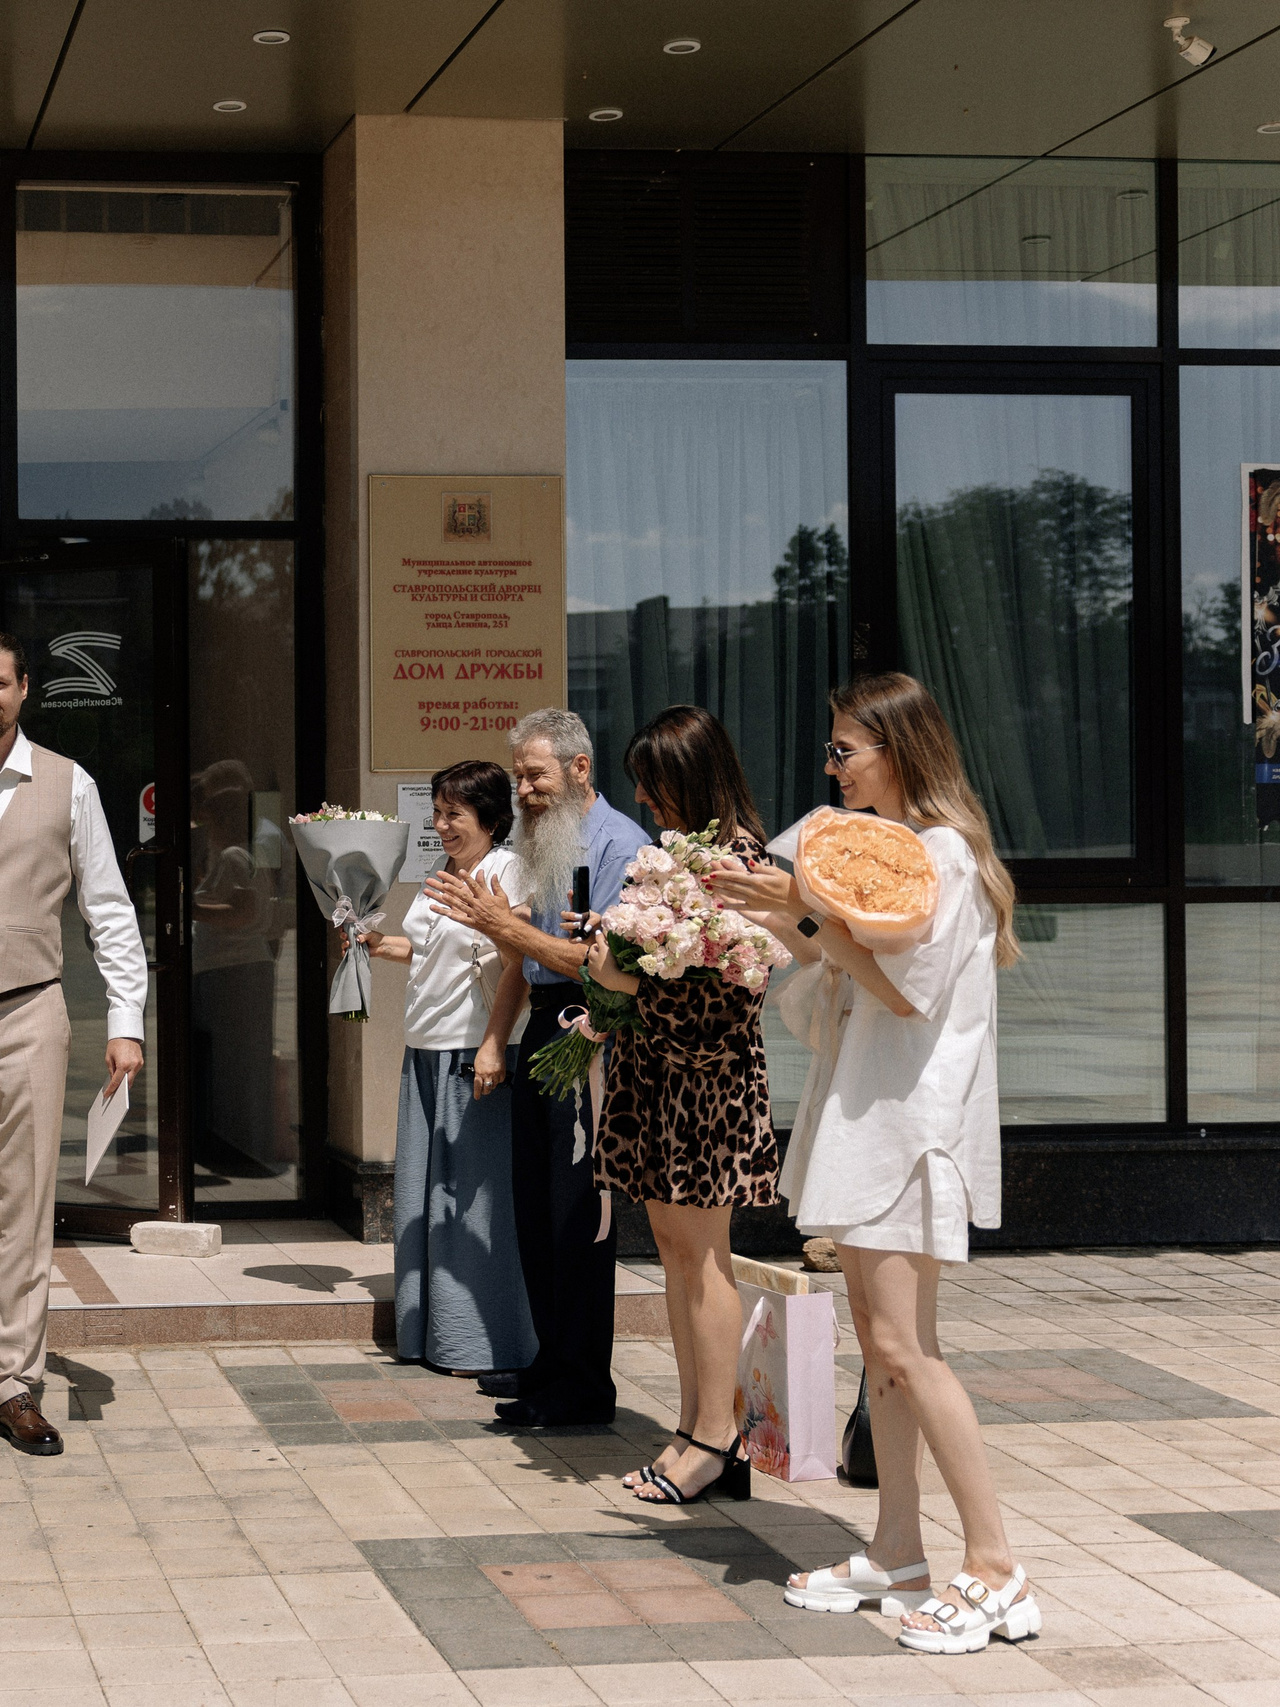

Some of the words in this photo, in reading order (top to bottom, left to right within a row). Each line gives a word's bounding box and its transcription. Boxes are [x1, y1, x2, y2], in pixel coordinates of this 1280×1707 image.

[402, 558, 476, 568] Муниципальное
[417, 569, 472, 577] учреждение
[474, 569, 517, 577] культуры
[393, 583, 497, 593] СТАВРОПОЛЬСКИЙ
[498, 585, 542, 594] ДВОРЕЦ
[453, 611, 511, 620] Ставрополь,
[426, 622, 452, 630] улица
[453, 620, 491, 630] Ленина,
[394, 648, 481, 658] СТАВРОПОЛЬСКИЙ
[486, 648, 542, 658] ГОРОДСКОЙ
[393, 663, 444, 680] ДОМ
[455, 663, 543, 680] ДРУЖБЫ
[418, 700, 459, 713] время
[462, 697, 519, 713] работы:
